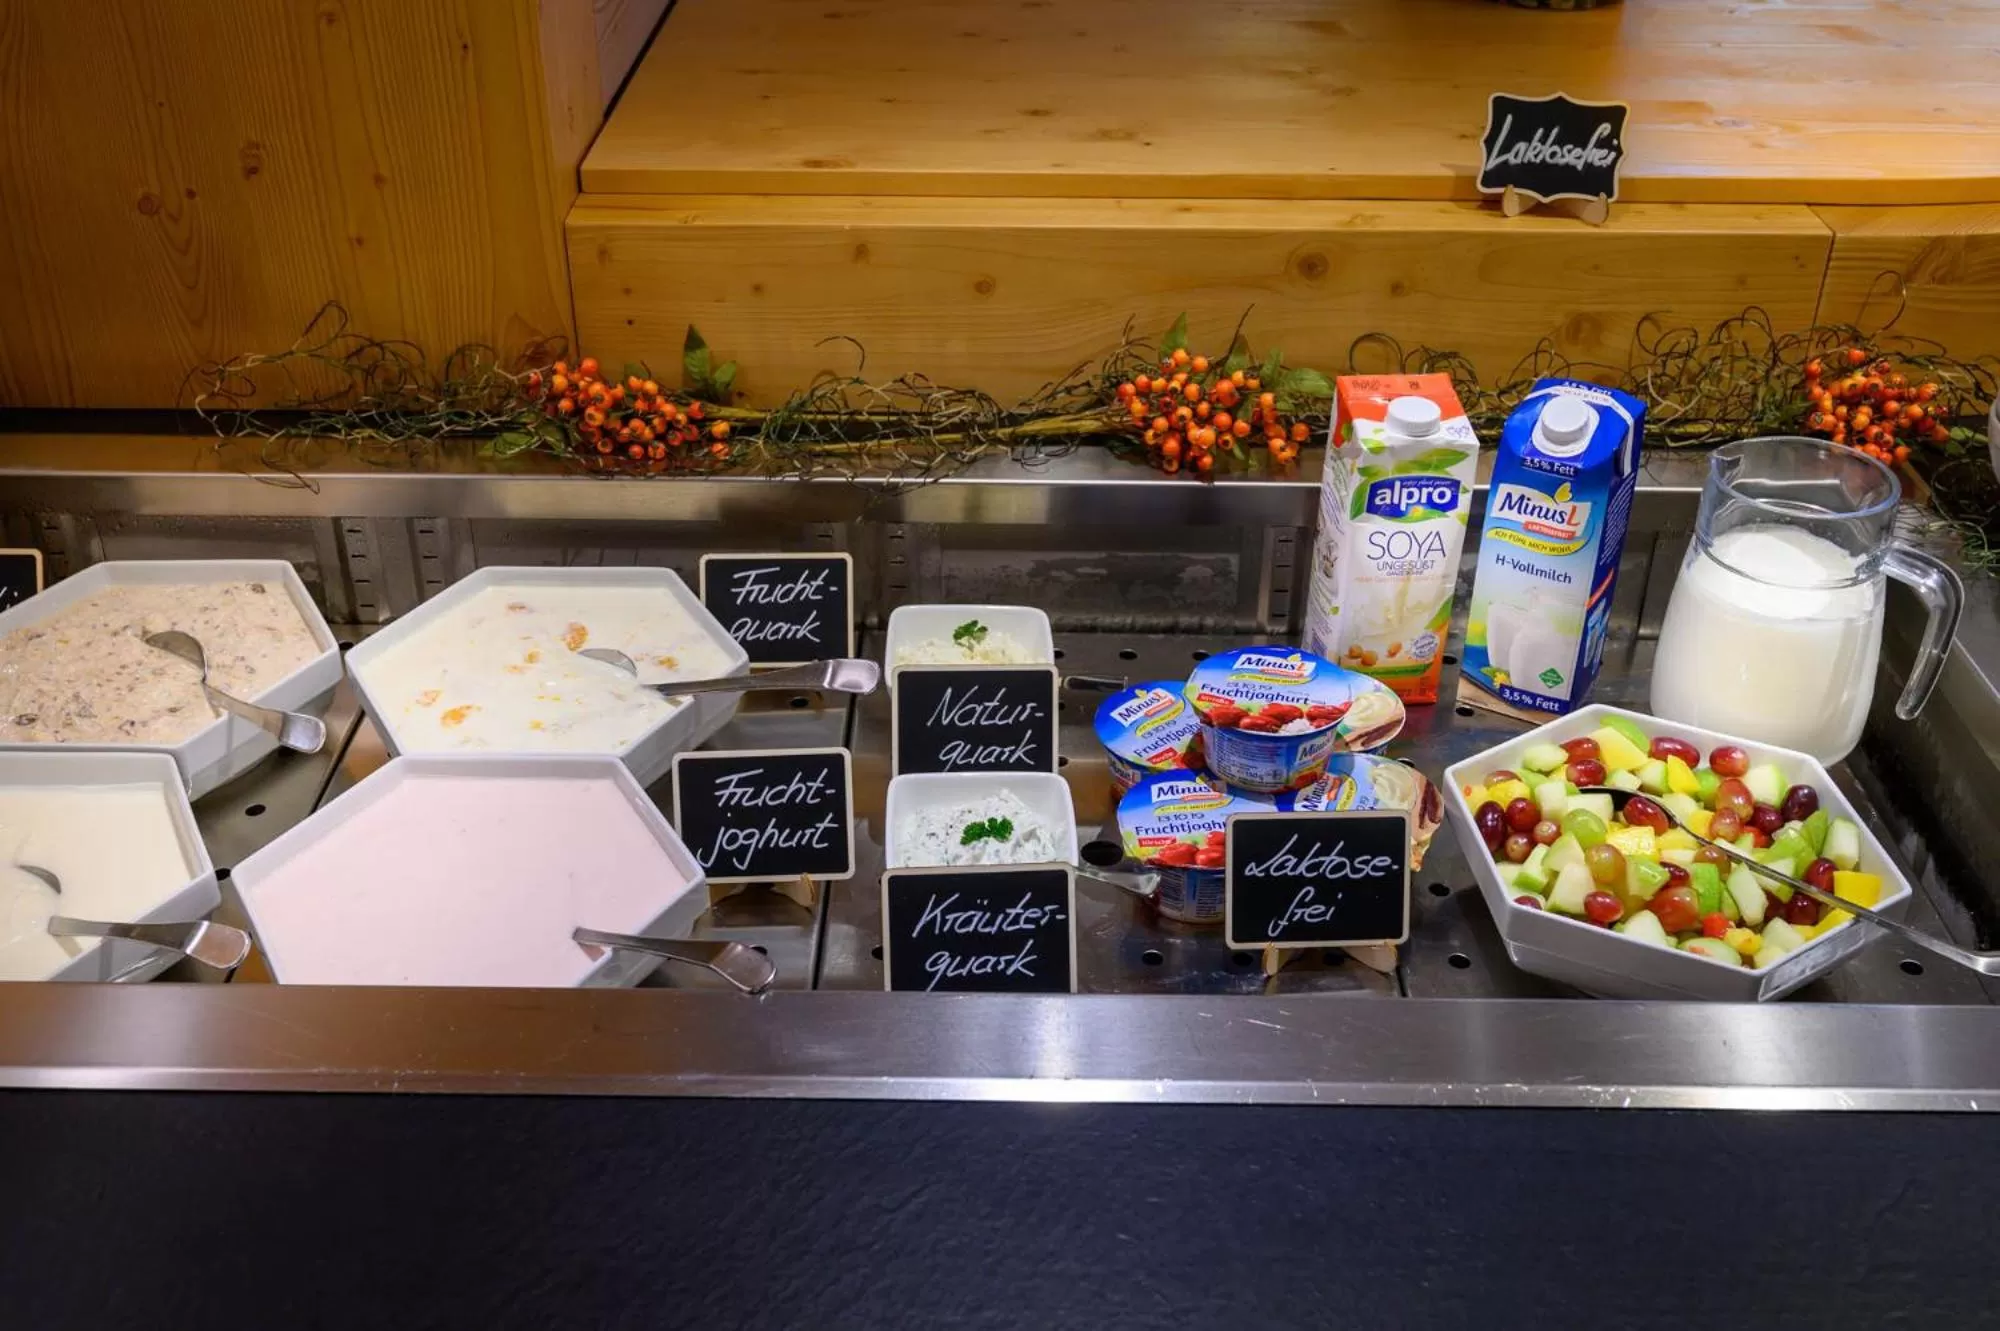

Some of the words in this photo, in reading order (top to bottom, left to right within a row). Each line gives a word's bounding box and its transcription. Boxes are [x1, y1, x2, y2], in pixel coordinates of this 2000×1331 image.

[1486, 114, 1618, 172] Laktosefrei
[1553, 462, 1575, 476] Fett
[1374, 480, 1452, 512] alpro
[1499, 491, 1581, 526] MinusL
[1367, 530, 1446, 560] SOYA
[730, 566, 838, 605] Frucht-
[1496, 554, 1572, 584] H-Vollmilch
[730, 609, 821, 642] quark
[926, 685, 1045, 726] Natur-
[1200, 683, 1310, 706] Fruchtjoghurt
[1536, 697, 1560, 711] Fett
[938, 729, 1037, 773] quark
[714, 768, 836, 808] Frucht-
[696, 812, 839, 871] joghurt
[1245, 833, 1399, 878] Laktose-
[912, 891, 1067, 938] Kräuter-
[1268, 886, 1342, 937] frei
[925, 939, 1037, 991] quark
